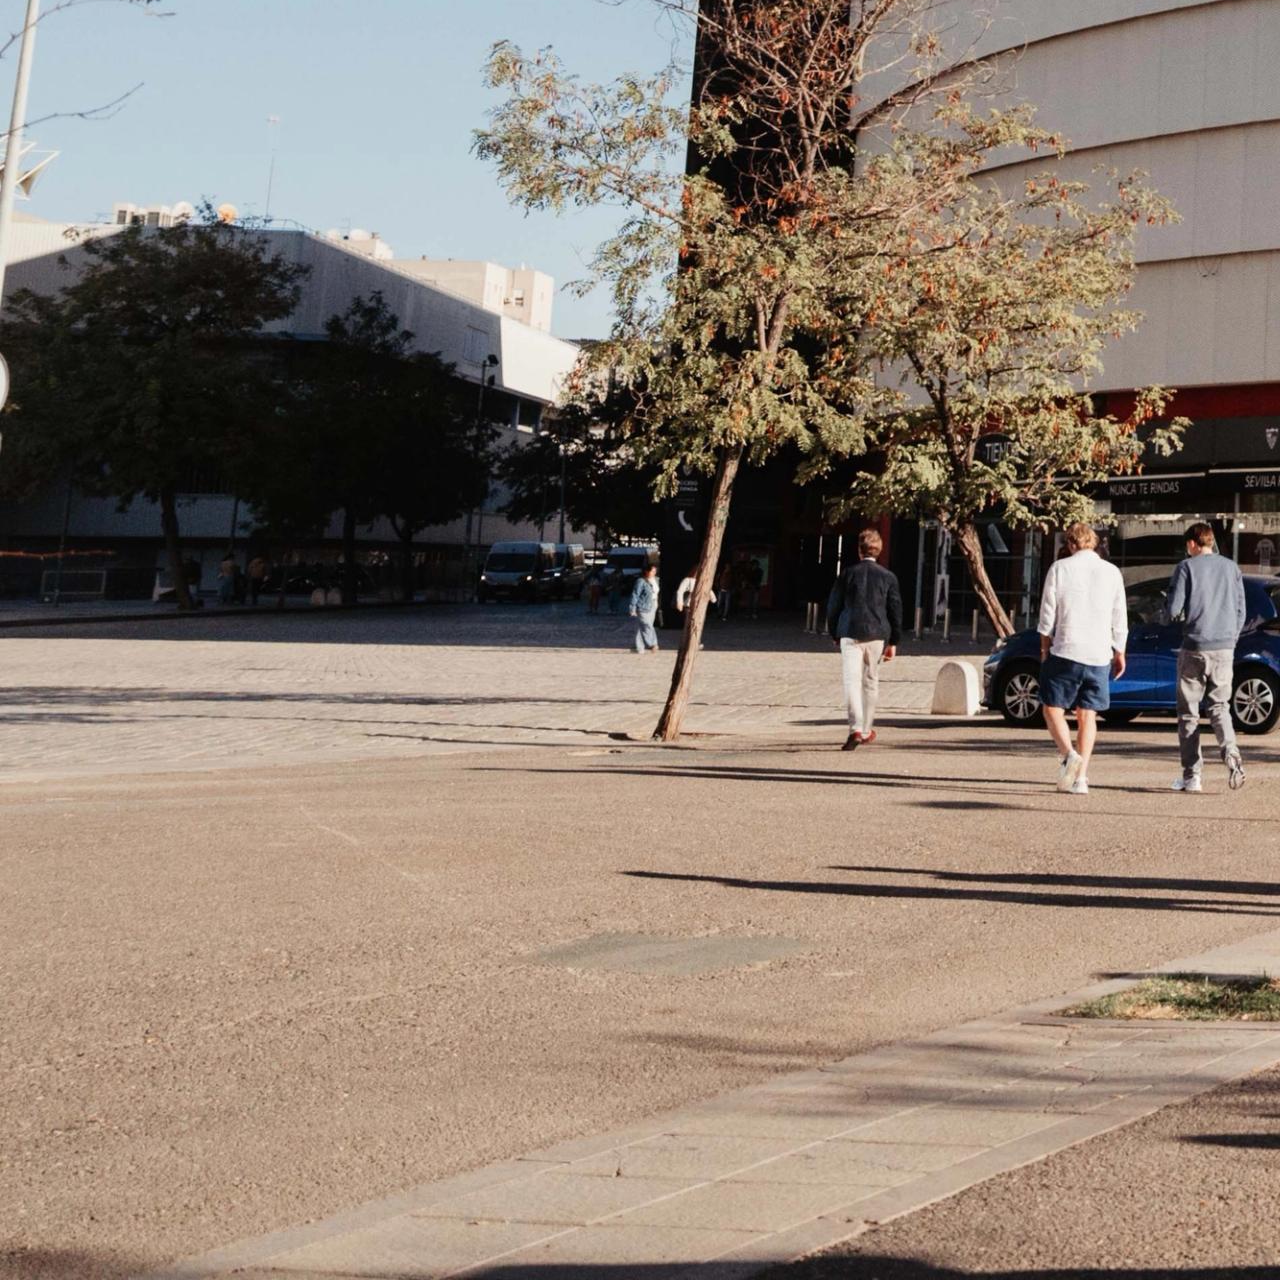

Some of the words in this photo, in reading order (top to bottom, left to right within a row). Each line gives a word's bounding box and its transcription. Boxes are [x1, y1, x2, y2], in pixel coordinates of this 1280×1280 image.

[1109, 483, 1137, 496] NUNCA
[1139, 482, 1149, 495] TE
[1150, 481, 1180, 494] RINDAS
[1244, 475, 1277, 488] SEVILLA
